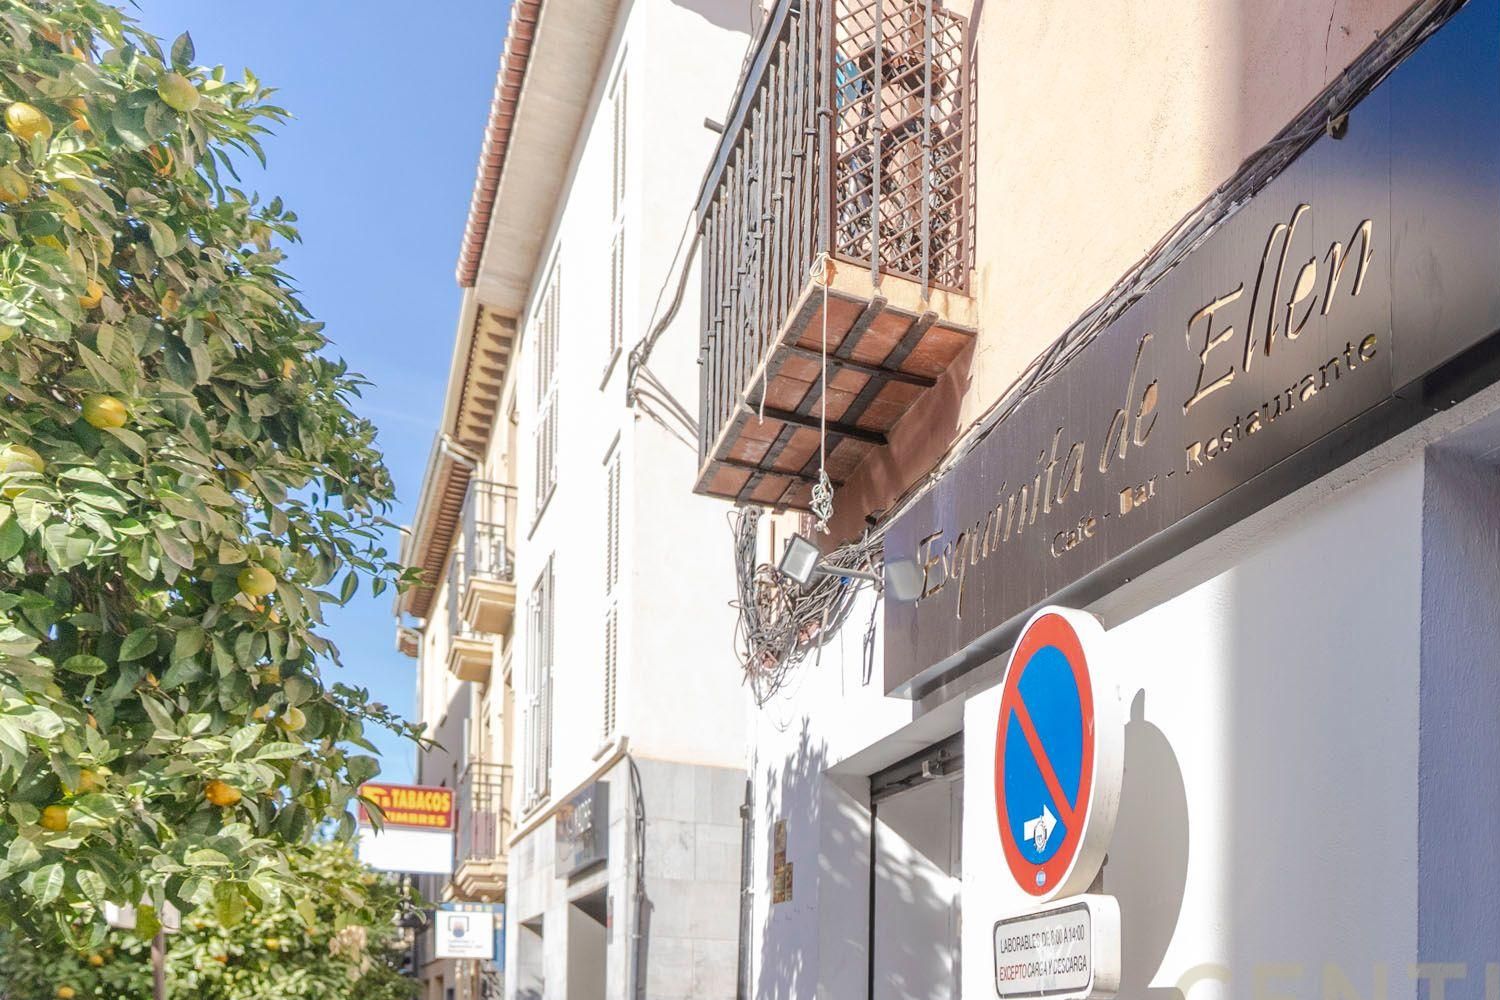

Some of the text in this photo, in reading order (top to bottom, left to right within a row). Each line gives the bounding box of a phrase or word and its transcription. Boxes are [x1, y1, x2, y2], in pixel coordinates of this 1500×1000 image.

[915, 203, 1373, 619] Esquinita de Ellen
[1118, 474, 1158, 518] Bar
[1184, 333, 1378, 475] Restaurante
[391, 788, 451, 813] TABACOS
[1000, 932, 1041, 954] LABORABLES
[1041, 931, 1051, 947] DE
[1000, 963, 1026, 981] EXCEPTO
[1027, 960, 1048, 978] CARGA
[1053, 954, 1088, 975] DESCARGA
